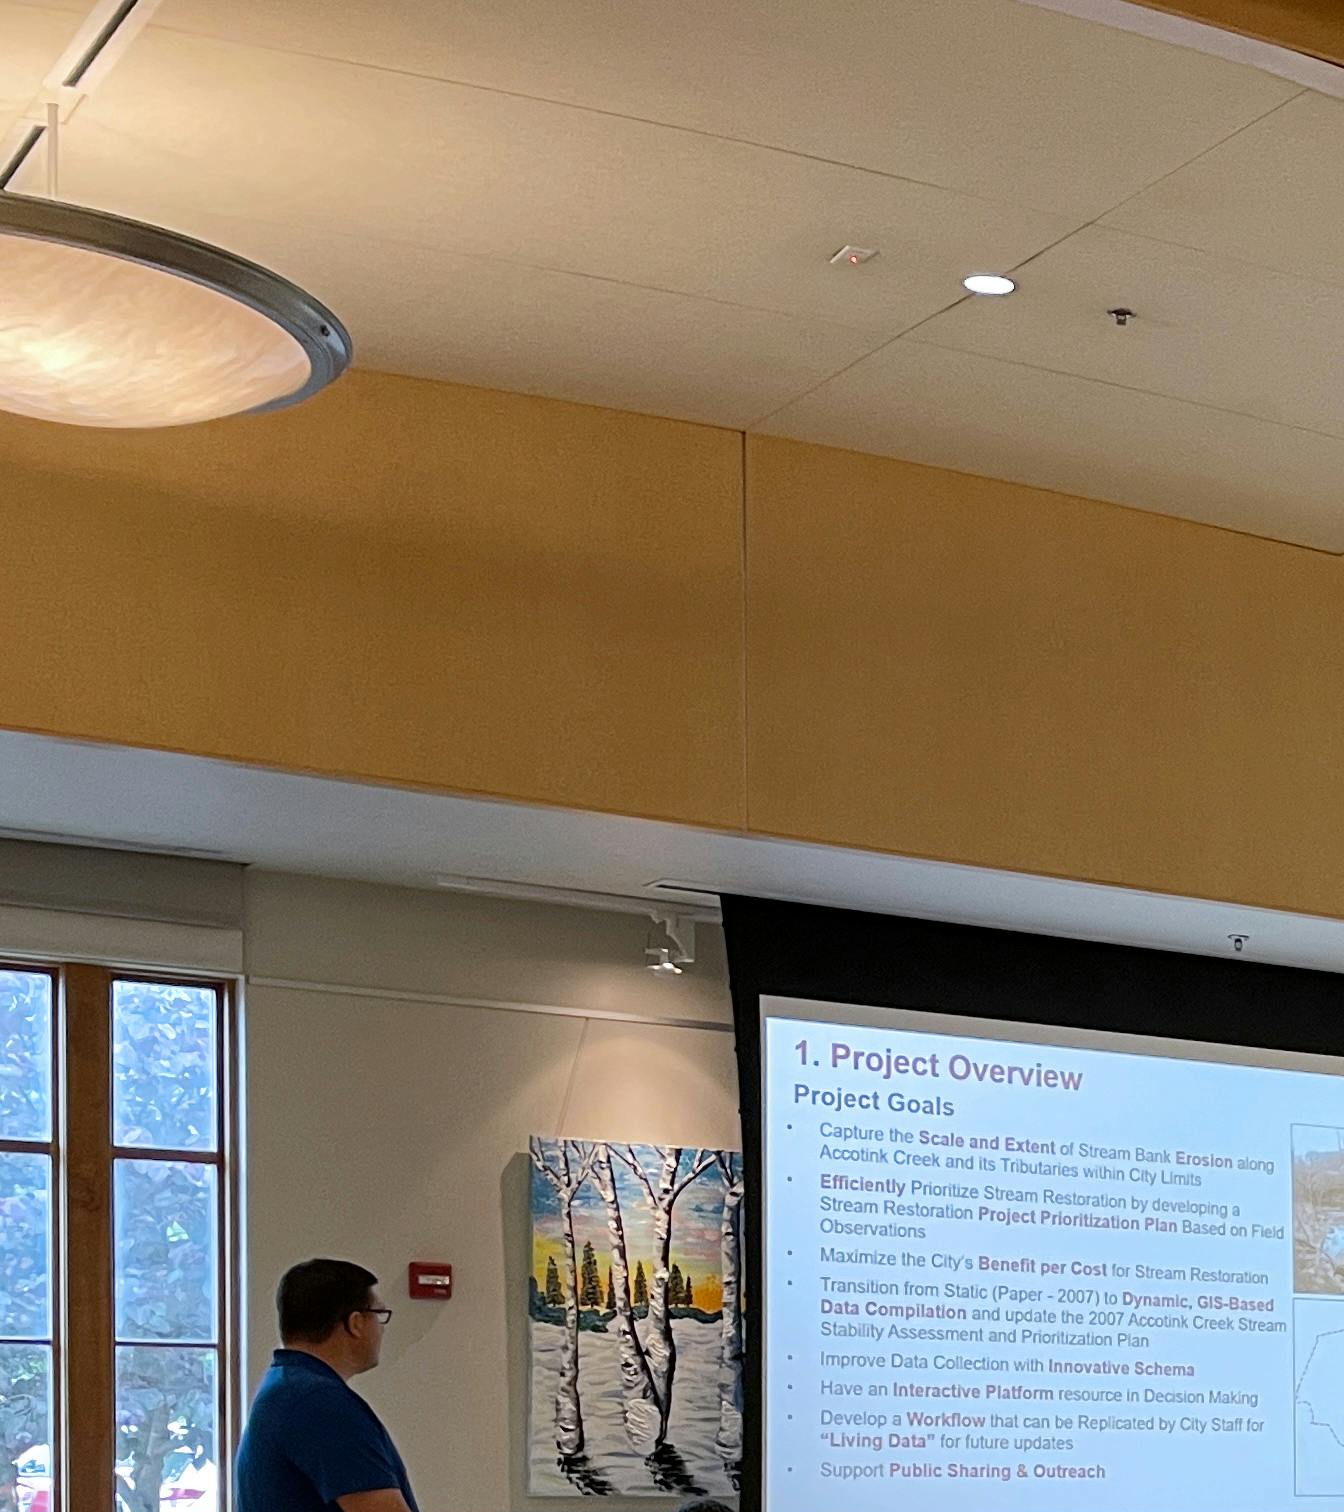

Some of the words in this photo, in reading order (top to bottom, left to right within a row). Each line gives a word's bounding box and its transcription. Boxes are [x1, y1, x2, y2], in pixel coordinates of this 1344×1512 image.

[795, 1040, 819, 1066] 1.
[831, 1042, 940, 1079] Project
[949, 1054, 1083, 1091] Overview
[795, 1084, 879, 1111] Project
[888, 1092, 955, 1116] Goals
[820, 1122, 884, 1142] Capture
[889, 1128, 914, 1143] the
[919, 1130, 964, 1148] Scale
[969, 1136, 999, 1150] and
[1005, 1137, 1056, 1155] Extent
[1060, 1142, 1074, 1155] of
[1079, 1143, 1131, 1161] Stream
[1135, 1148, 1170, 1164] Bank
[1176, 1151, 1233, 1169] Erosion
[1237, 1157, 1274, 1175] along
[820, 1144, 888, 1164] Accotink
[893, 1150, 940, 1168] Creek
[946, 1155, 973, 1170] and
[979, 1157, 996, 1171] its
[1001, 1157, 1078, 1177] Tributaries
[1083, 1165, 1124, 1181] within
[1129, 1168, 1157, 1186] City
[1161, 1170, 1202, 1187] Limits
[820, 1174, 906, 1197] Efficiently
[911, 1180, 979, 1199] Prioritize
[984, 1185, 1038, 1203] Stream
[1043, 1189, 1127, 1209] Restoration
[1131, 1196, 1148, 1213] by
[1152, 1198, 1228, 1218] developing
[1232, 1204, 1240, 1217] a
[820, 1196, 878, 1214] Stream
[884, 1200, 973, 1220] Restoration
[978, 1206, 1036, 1226] Project
[1040, 1211, 1140, 1231] Prioritization
[1144, 1218, 1177, 1233] Plan
[1182, 1220, 1226, 1236] Based
[1230, 1226, 1247, 1237] on
[1251, 1224, 1285, 1240] Field
[820, 1218, 926, 1239] Observations
[820, 1247, 896, 1266] Maximize
[902, 1252, 926, 1267] the
[978, 1256, 1036, 1273] Benefit
[1040, 1262, 1066, 1276] per
[1071, 1261, 1107, 1276] Cost
[1112, 1263, 1130, 1278] for
[1135, 1265, 1186, 1281] Stream
[1190, 1267, 1269, 1285] Restoration
[820, 1277, 899, 1295] Transition
[904, 1281, 939, 1297] from
[944, 1283, 988, 1299] Static
[992, 1285, 1042, 1304] (Paper
[1057, 1289, 1100, 1305] 2007)
[1104, 1291, 1118, 1305] to
[1122, 1291, 1193, 1310] Dynamic,
[1198, 1295, 1274, 1312] GIS-Based
[820, 1299, 860, 1315] Data
[865, 1301, 967, 1321] Compilation
[972, 1307, 1000, 1321] and
[1005, 1309, 1056, 1325] update
[1061, 1310, 1084, 1325] the
[1088, 1311, 1124, 1326] 2007
[1128, 1313, 1188, 1329] Accotink
[1192, 1315, 1234, 1331] Creek
[1238, 1317, 1287, 1333] Stream
[820, 1321, 884, 1341] Stability
[888, 1324, 984, 1343] Assessment
[989, 1328, 1016, 1343] and
[1022, 1330, 1112, 1346] Prioritization
[1117, 1332, 1149, 1348] Plan
[820, 1352, 885, 1369] Improve
[891, 1353, 928, 1369] Data
[933, 1355, 1009, 1372] Collection
[1014, 1358, 1044, 1372] with
[1049, 1359, 1129, 1375] Innovative
[1134, 1361, 1195, 1377] Schema
[820, 1380, 863, 1396] Have
[868, 1384, 888, 1396] an
[893, 1382, 980, 1399] Interactive
[986, 1385, 1054, 1400] Platform
[1058, 1388, 1122, 1402] resource
[1127, 1388, 1139, 1402] in
[1144, 1389, 1204, 1404] Decision
[1209, 1391, 1258, 1407] Making
[820, 1410, 887, 1428] Develop
[892, 1414, 901, 1426] a
[906, 1412, 986, 1428] Workflow
[990, 1414, 1019, 1428] that
[1023, 1416, 1050, 1429] can
[1055, 1415, 1073, 1430] be
[1078, 1415, 1154, 1432] Replicated
[1159, 1417, 1176, 1434] by
[1180, 1417, 1207, 1434] City
[1211, 1417, 1243, 1432] Staff
[1247, 1417, 1264, 1432] for
[940, 1434, 961, 1449] for
[965, 1434, 1009, 1450] future
[1014, 1437, 1074, 1452] updates
[820, 1462, 884, 1479] Support
[889, 1463, 942, 1478] Public
[947, 1464, 1010, 1481] Sharing
[1017, 1464, 1028, 1478] &
[1034, 1464, 1106, 1479] Outreach
